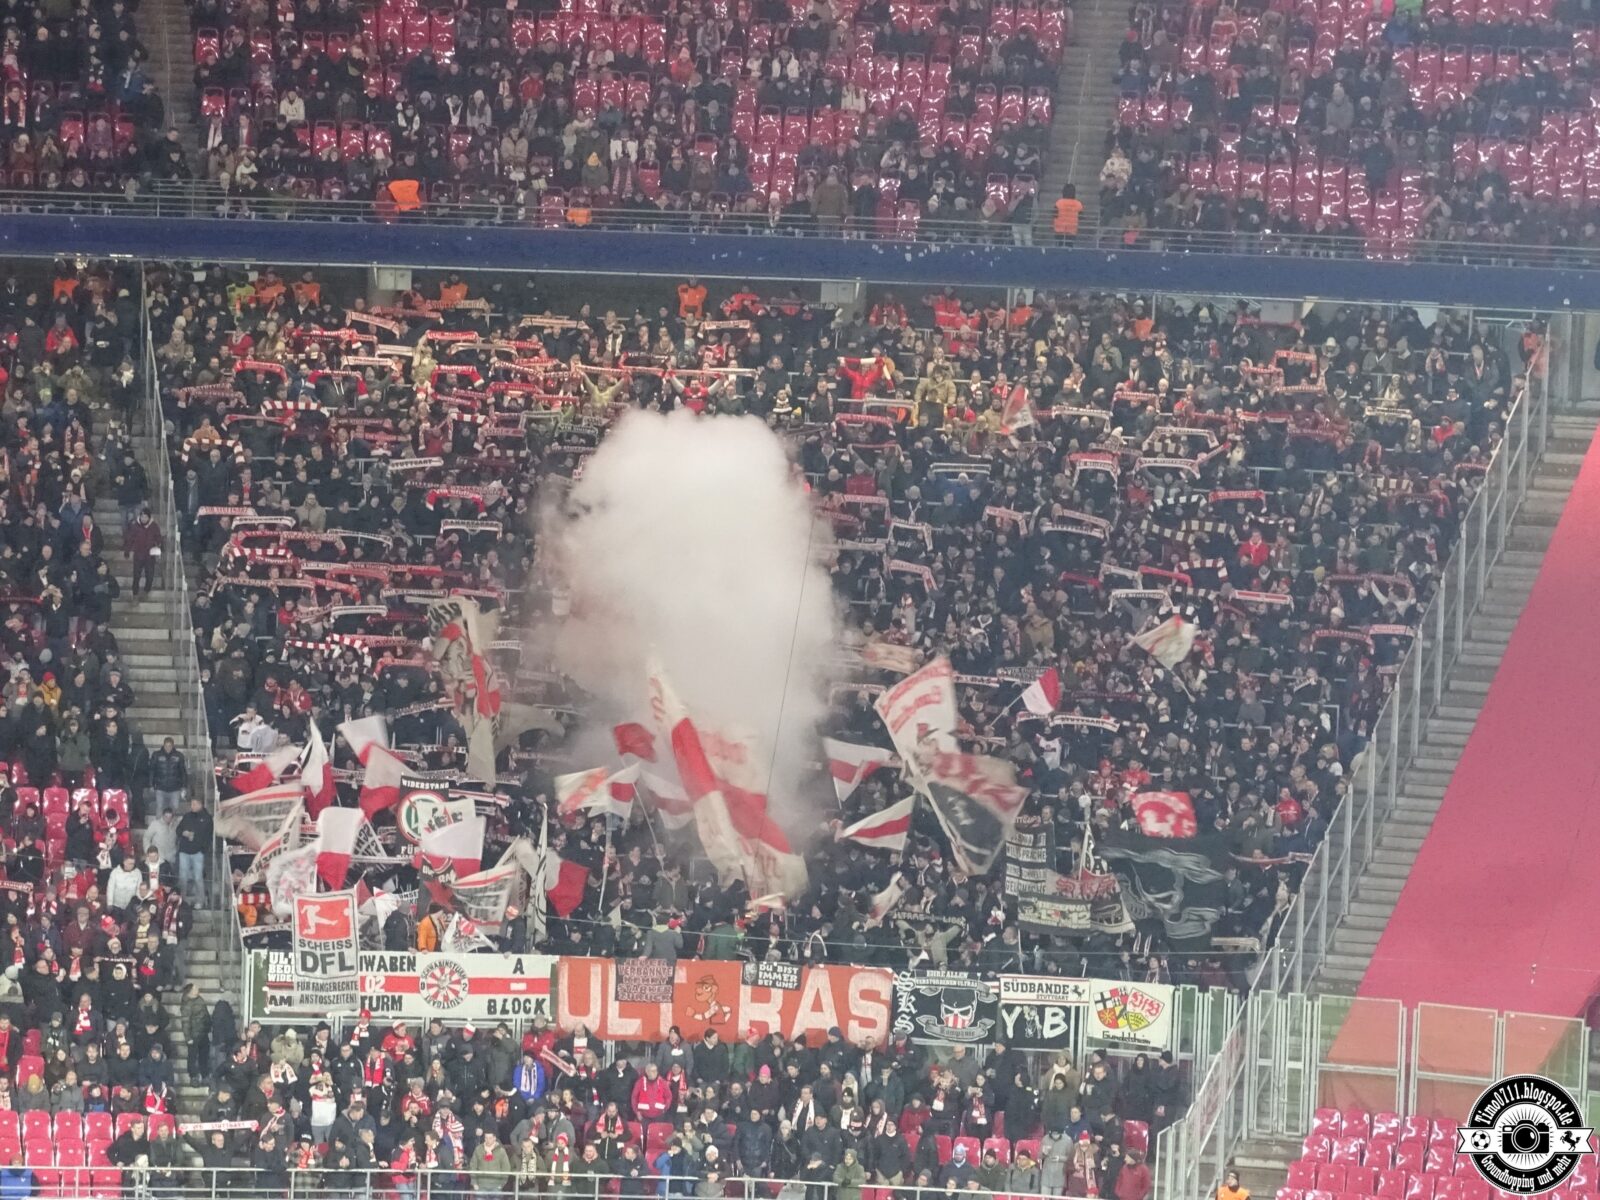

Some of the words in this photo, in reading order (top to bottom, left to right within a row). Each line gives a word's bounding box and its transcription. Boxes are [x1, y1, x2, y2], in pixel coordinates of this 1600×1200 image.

[298, 939, 353, 951] SCHEISS
[300, 951, 355, 975] DFL
[512, 957, 525, 975] A
[759, 963, 773, 971] DU
[777, 965, 799, 974] BIST
[759, 971, 798, 982] IMMER
[297, 980, 311, 992] FÜR
[1003, 978, 1070, 995] SÜDBANDE
[360, 995, 403, 1012] TURM
[1036, 993, 1069, 1001] STUTTGART
[487, 997, 547, 1015] BLOCK
